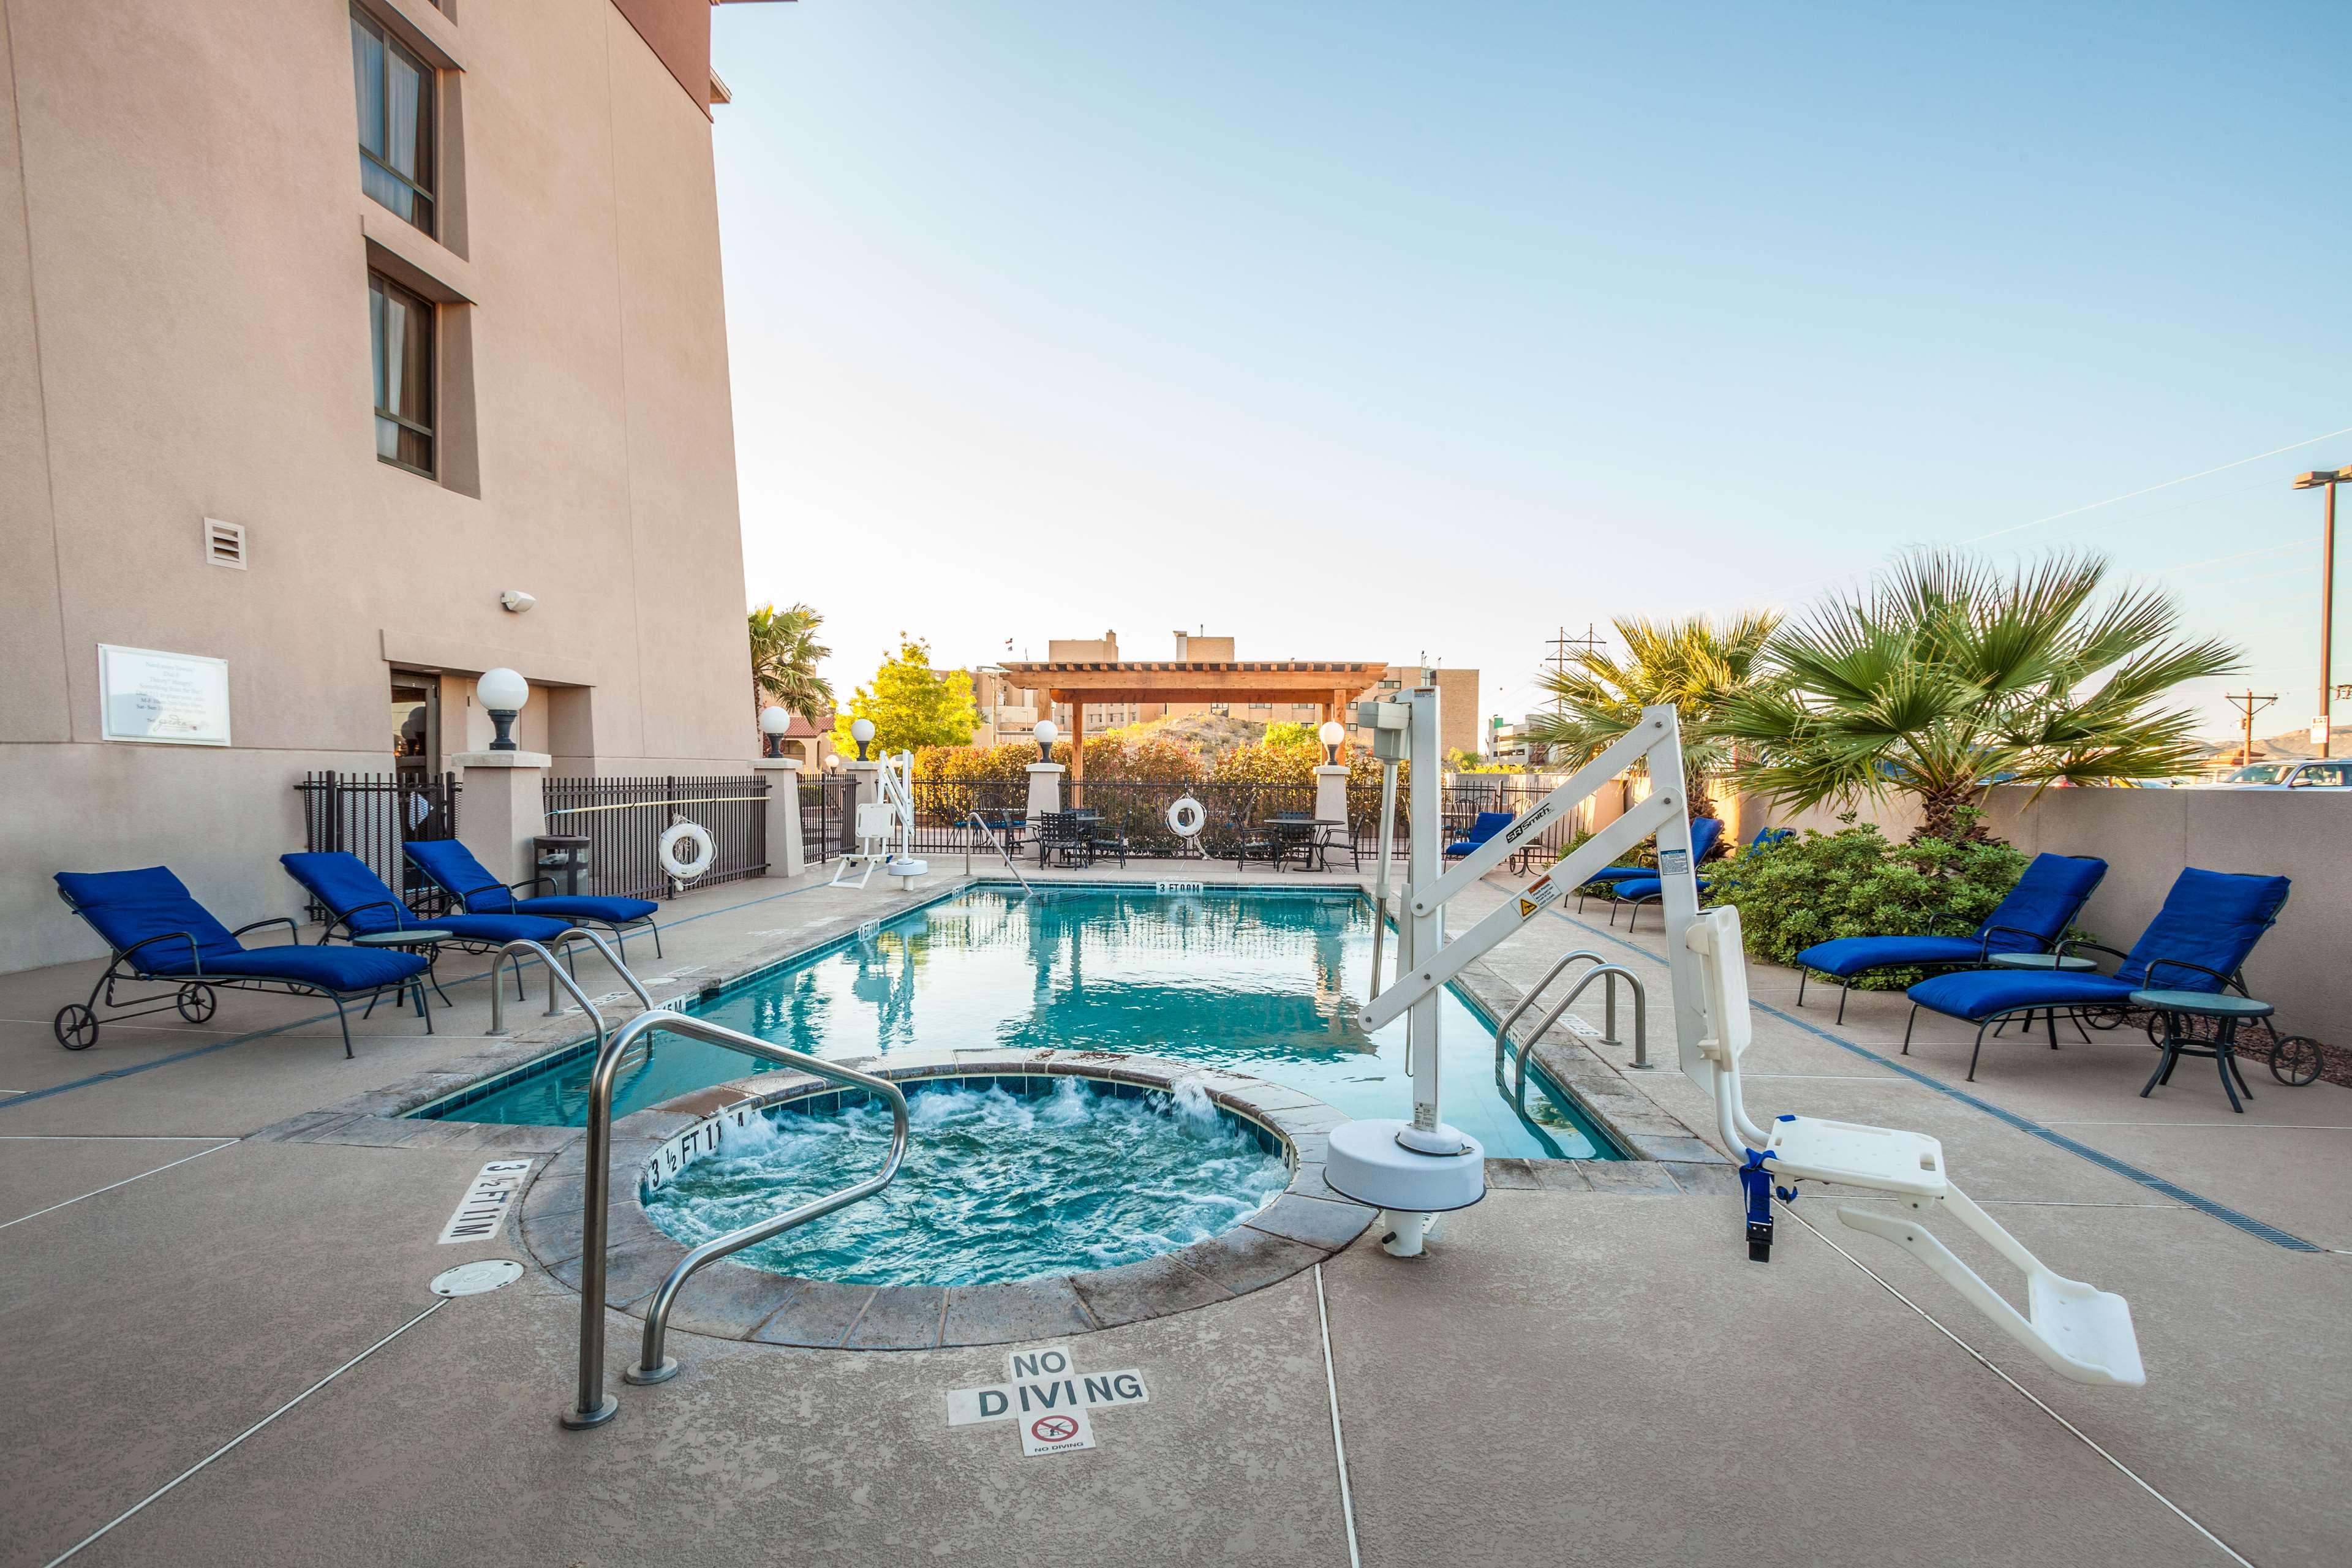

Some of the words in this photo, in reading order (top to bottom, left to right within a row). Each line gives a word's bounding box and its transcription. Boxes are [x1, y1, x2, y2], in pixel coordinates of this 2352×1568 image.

[1507, 826, 1523, 843] SR
[1522, 807, 1550, 831] Smith
[652, 1159, 660, 1187] 3
[682, 1130, 699, 1164] FT
[470, 1190, 510, 1204] FT
[459, 1208, 500, 1222] 1.1
[450, 1223, 494, 1237] M
[1013, 1351, 1066, 1378] NO
[978, 1374, 1143, 1417] DIVING
[1051, 1442, 1084, 1450] DIVING
